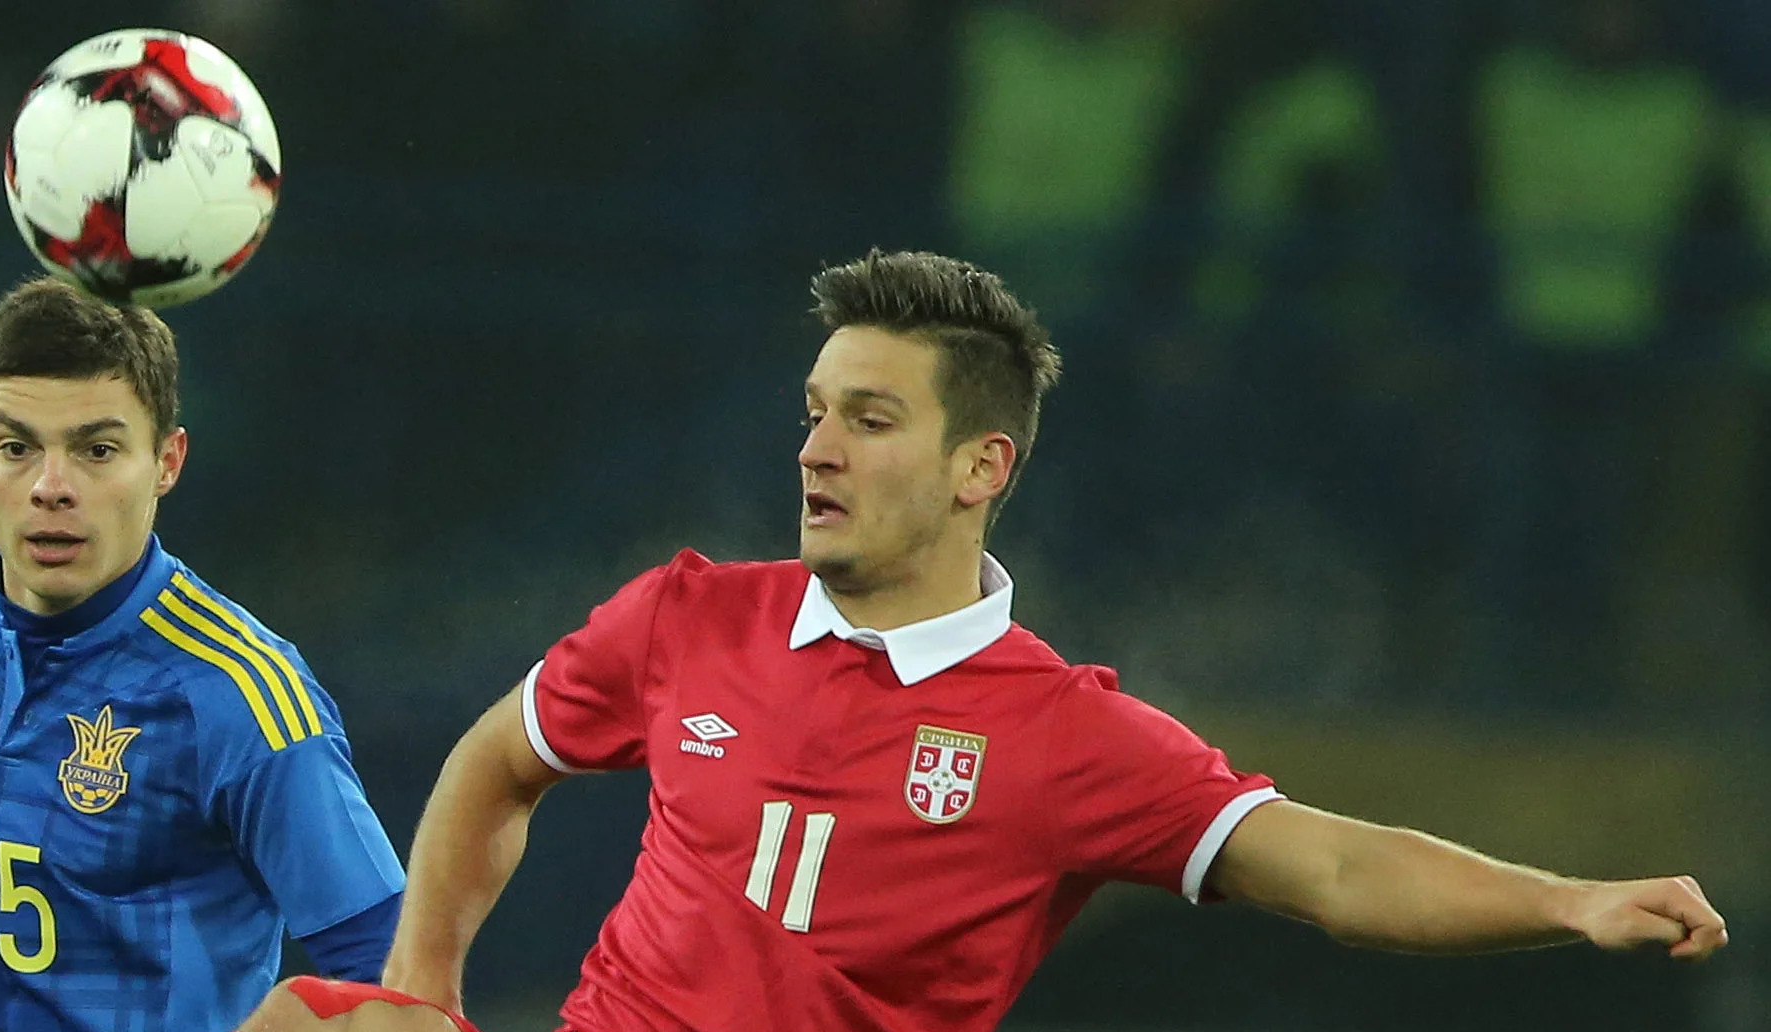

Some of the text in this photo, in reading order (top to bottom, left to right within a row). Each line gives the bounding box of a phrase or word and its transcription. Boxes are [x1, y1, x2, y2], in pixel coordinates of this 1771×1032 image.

[680, 739, 724, 758] umbro
[66, 765, 121, 788] УКРАЇНА
[744, 801, 836, 932] 11
